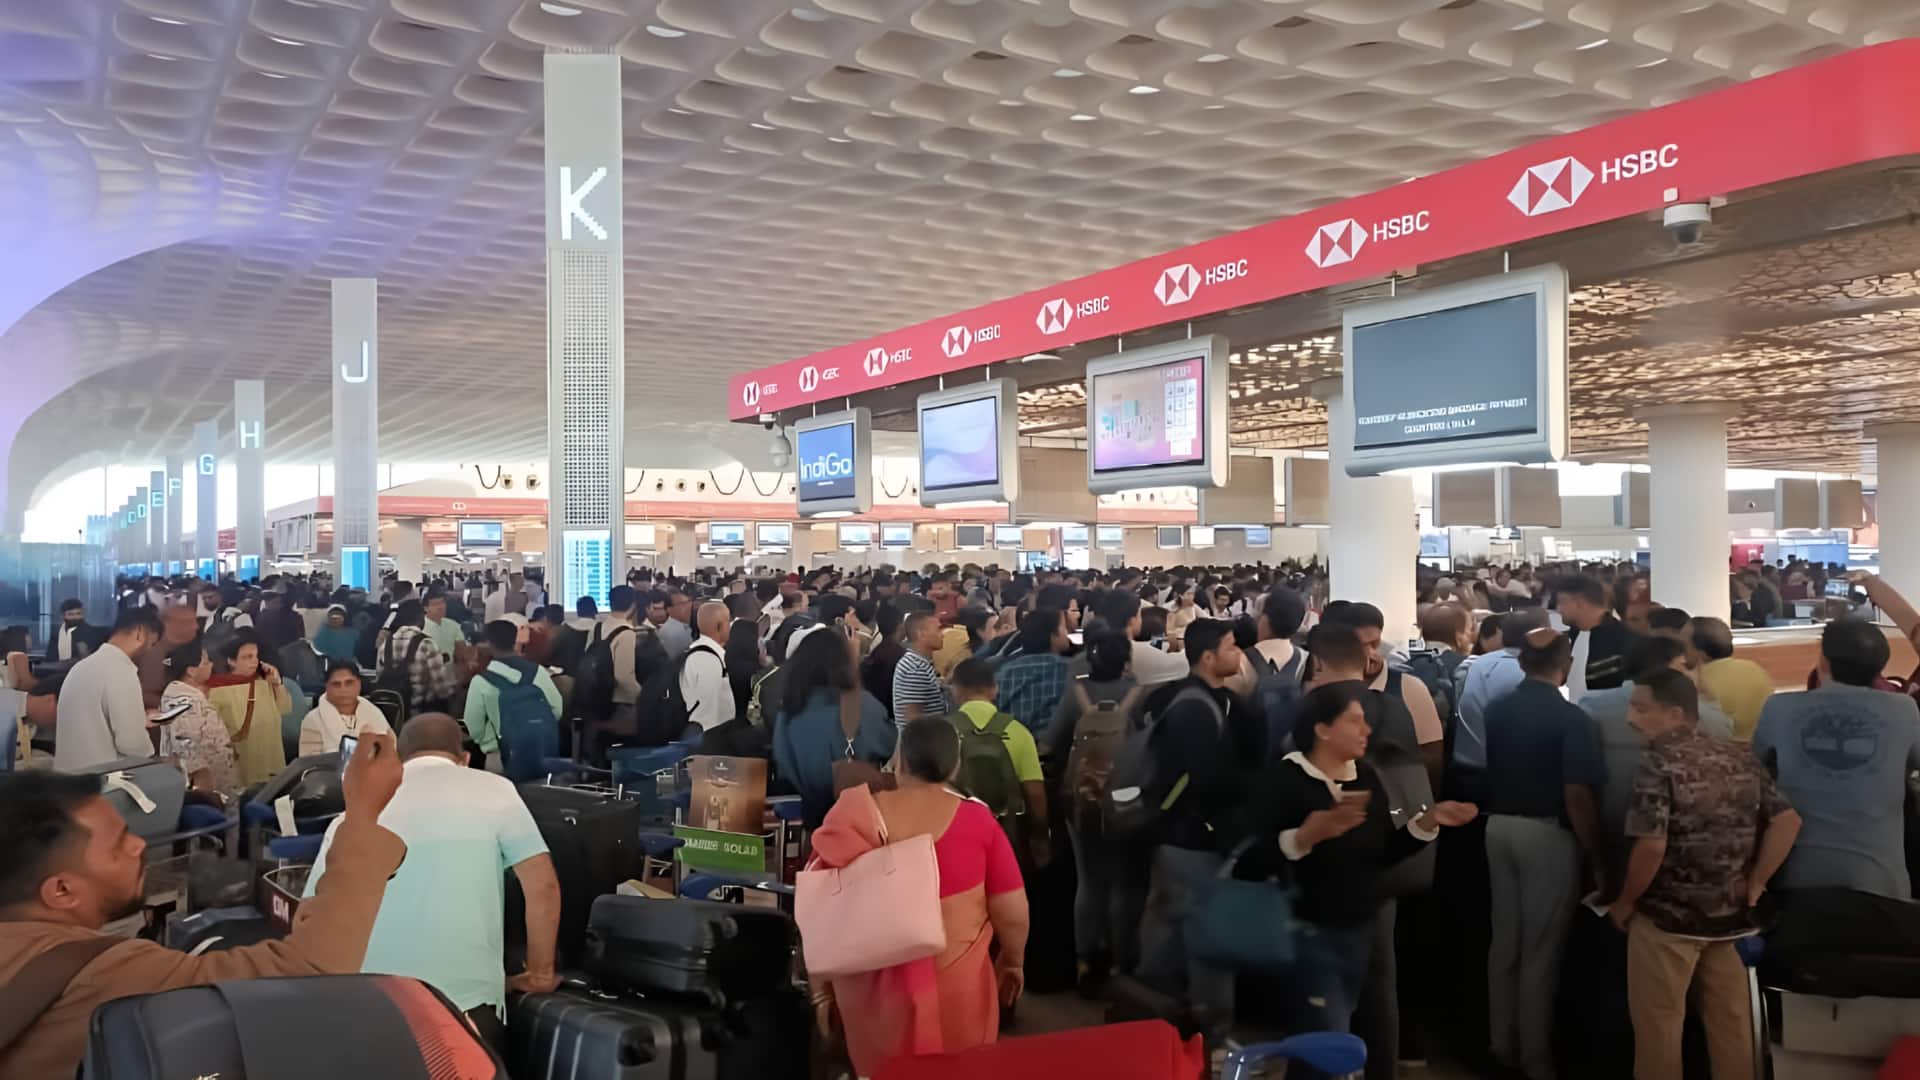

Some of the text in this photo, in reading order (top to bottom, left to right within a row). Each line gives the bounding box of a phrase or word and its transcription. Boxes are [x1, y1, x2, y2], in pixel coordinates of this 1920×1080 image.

[1601, 143, 1679, 185] HSBC
[559, 166, 609, 241] K
[1373, 210, 1431, 243] HSBC
[1205, 259, 1248, 285] HSBC
[1076, 295, 1110, 319] HSBC
[341, 340, 369, 383] J
[240, 421, 260, 449] H
[199, 454, 215, 475] G
[800, 452, 853, 480] IndiGo
[152, 491, 163, 507] E
